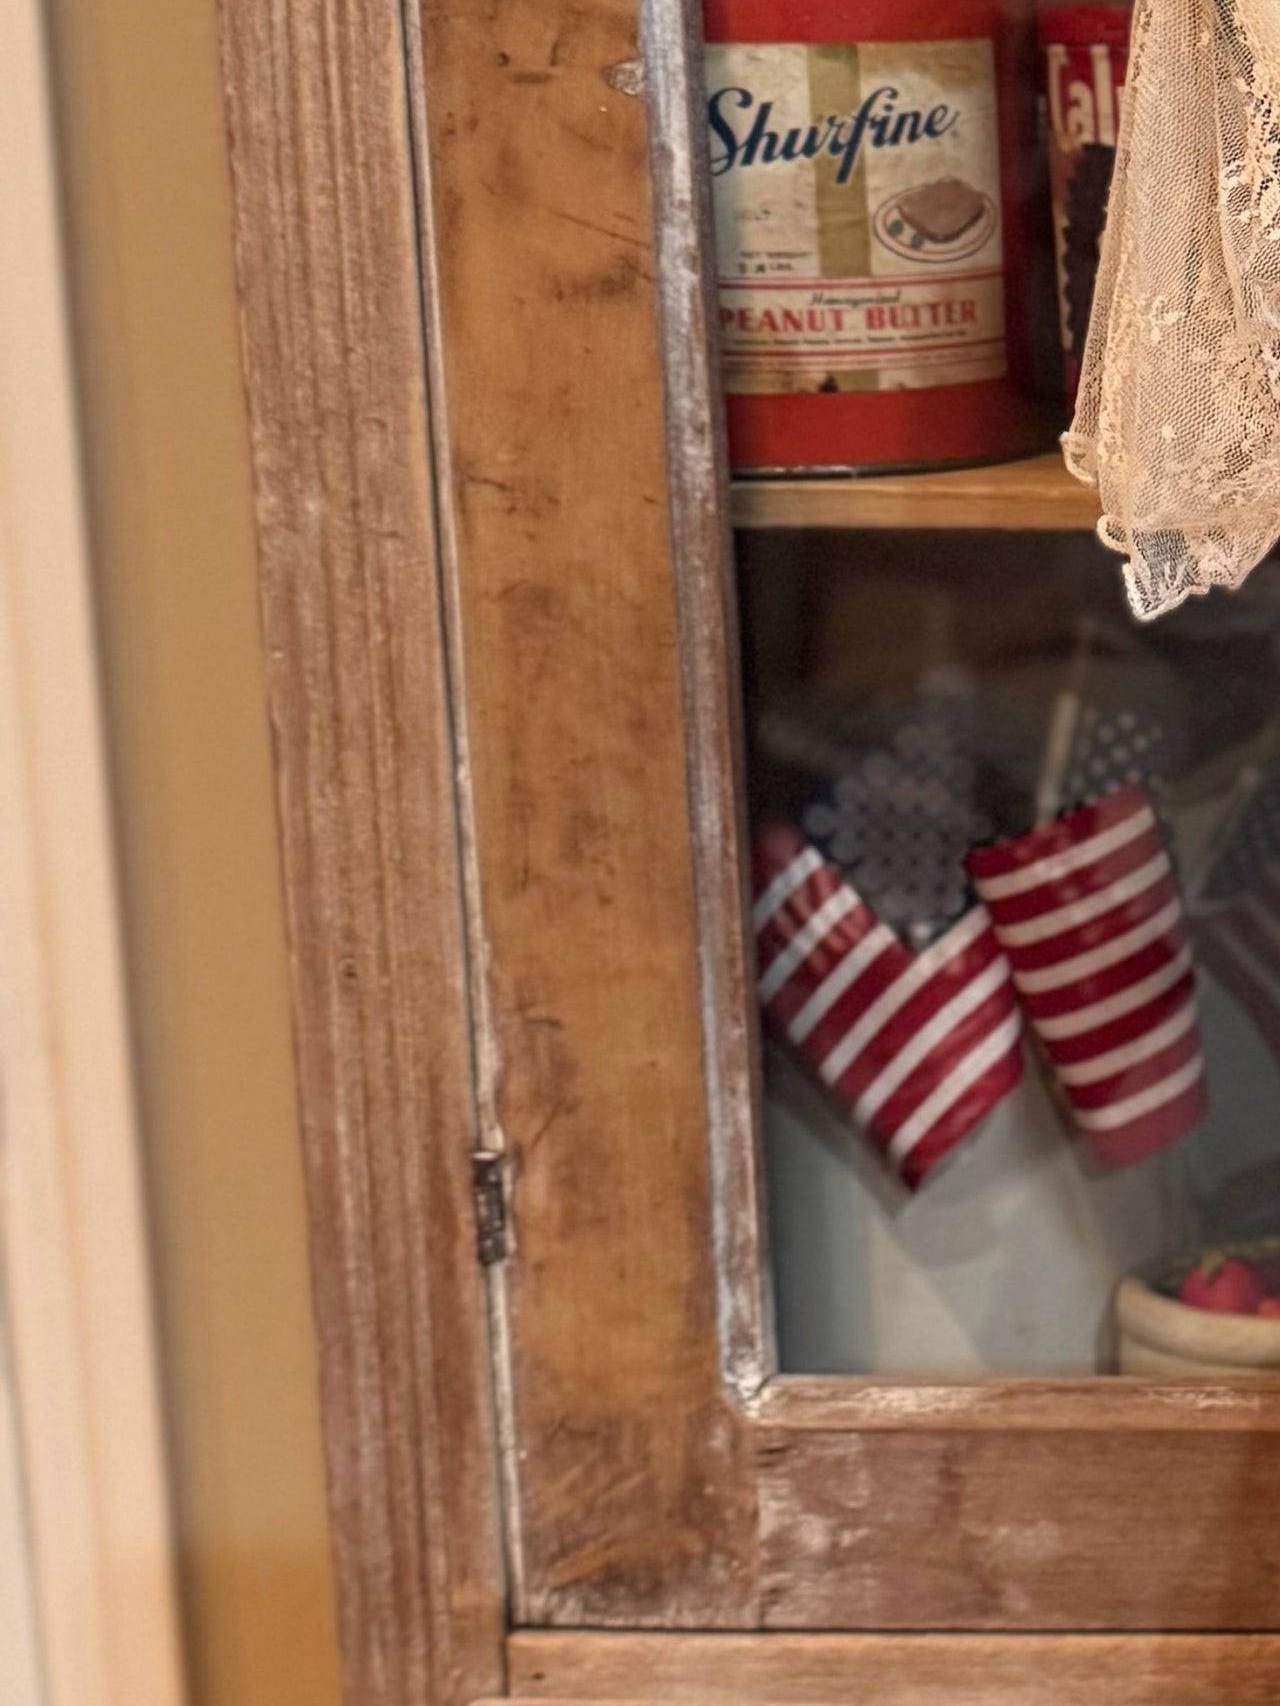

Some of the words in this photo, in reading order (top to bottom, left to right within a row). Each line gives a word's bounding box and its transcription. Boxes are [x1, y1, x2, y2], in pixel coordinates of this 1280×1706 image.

[709, 87, 961, 185] Shurfine
[718, 305, 848, 334] PEANUT
[864, 298, 977, 332] BUTTER
